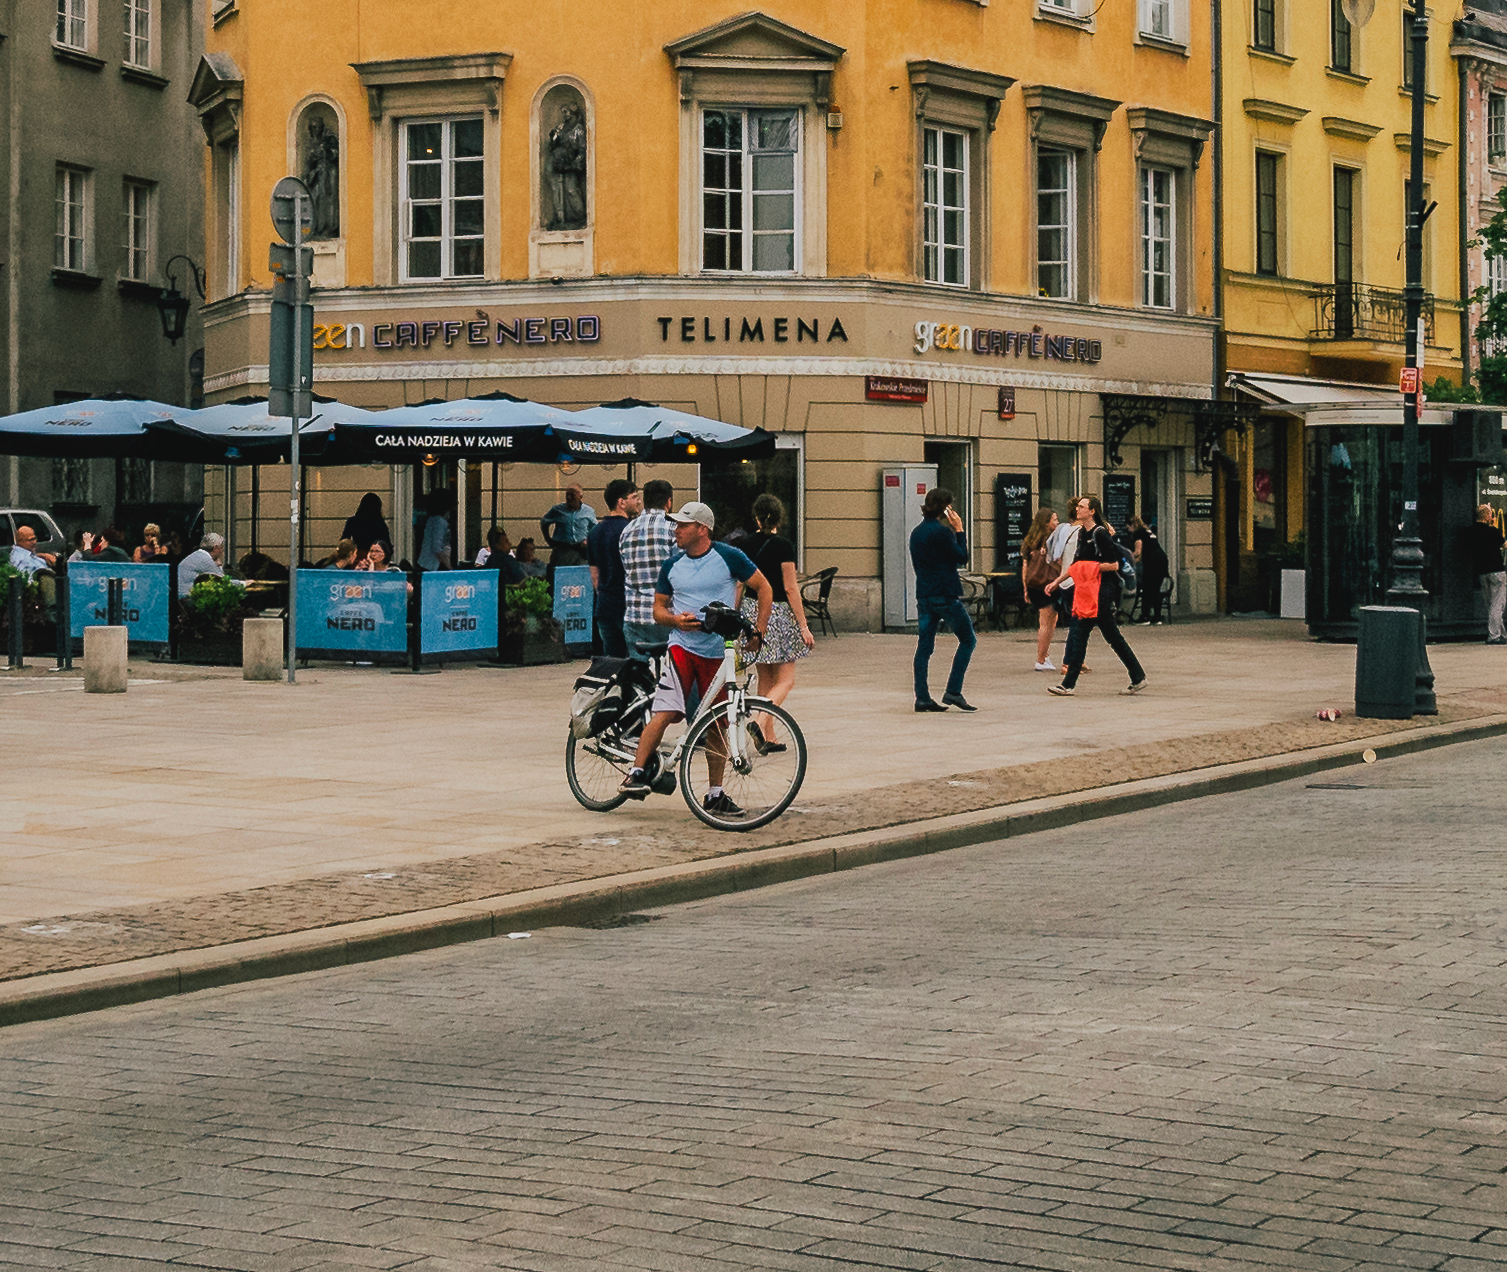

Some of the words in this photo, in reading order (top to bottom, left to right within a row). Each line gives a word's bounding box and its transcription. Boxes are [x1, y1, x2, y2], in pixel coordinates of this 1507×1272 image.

[313, 322, 365, 349] een
[495, 315, 599, 345] NERO
[657, 316, 849, 343] TELIMENA
[914, 320, 972, 353] green
[1046, 334, 1103, 362] NERO
[870, 381, 898, 392] Krakowskie
[1003, 398, 1015, 413] 27
[375, 435, 405, 447] CAŁA
[408, 436, 461, 447] NADZIEJA
[463, 436, 475, 447] W
[478, 436, 513, 447] KAWIE
[330, 584, 372, 601] green
[445, 585, 476, 603] green
[327, 617, 376, 631] NERO
[443, 618, 476, 632] NERO
[564, 618, 587, 631] ERO
